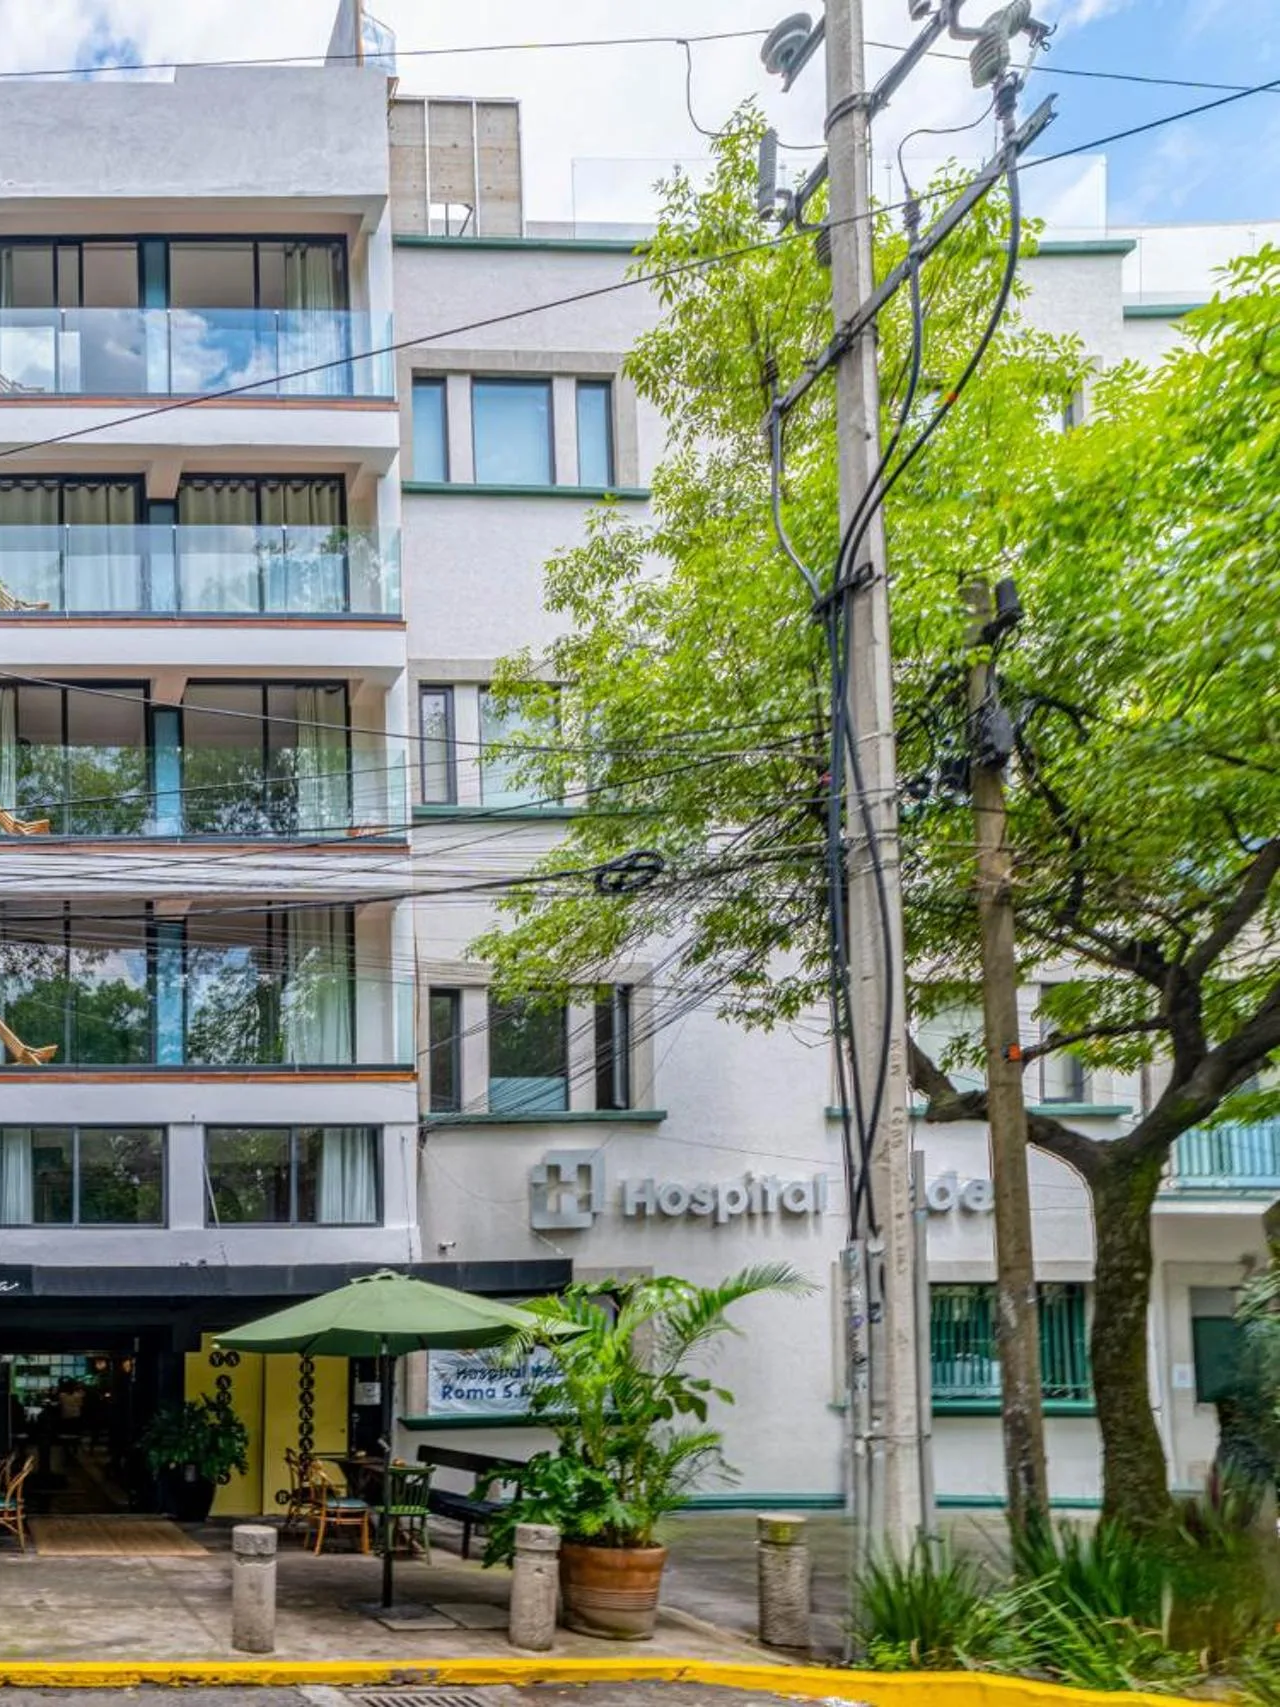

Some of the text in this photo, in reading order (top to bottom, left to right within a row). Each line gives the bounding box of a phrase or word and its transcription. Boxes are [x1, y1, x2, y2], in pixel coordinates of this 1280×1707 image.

[623, 1171, 994, 1224] Hospital de
[441, 1384, 496, 1399] Roma
